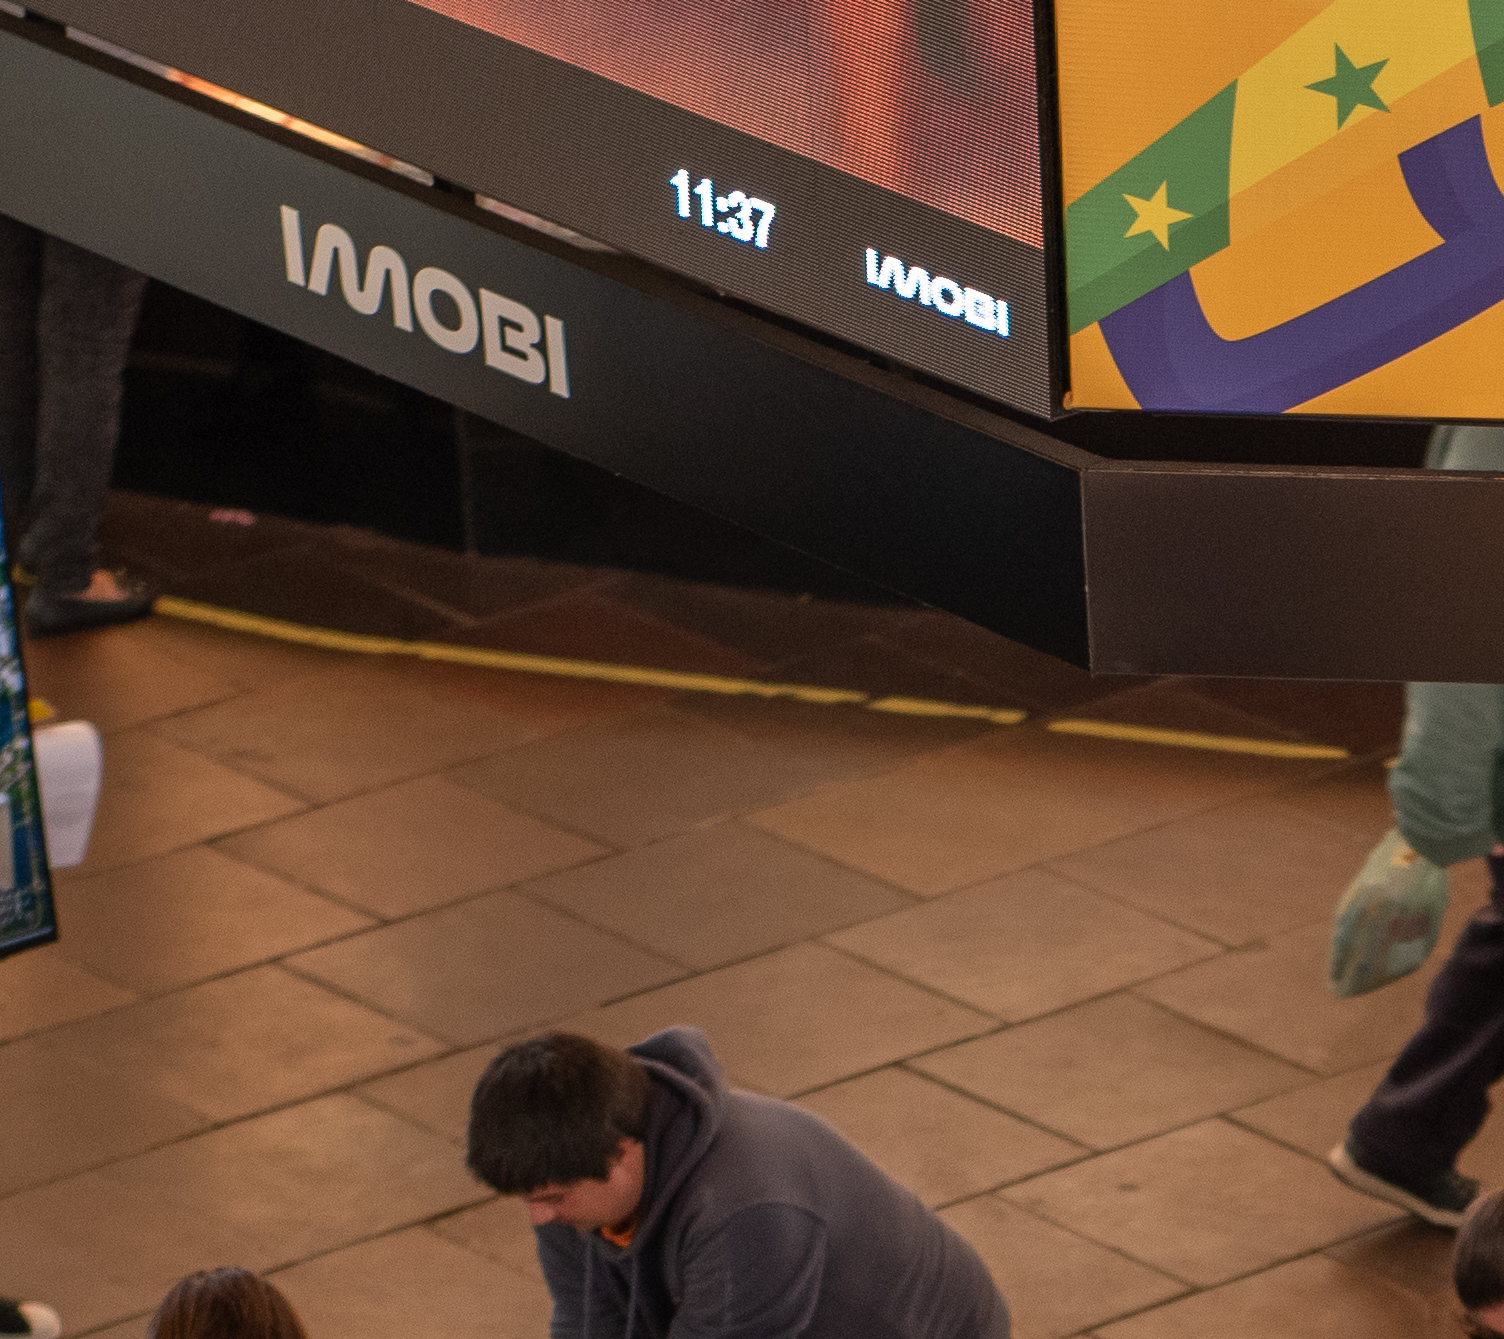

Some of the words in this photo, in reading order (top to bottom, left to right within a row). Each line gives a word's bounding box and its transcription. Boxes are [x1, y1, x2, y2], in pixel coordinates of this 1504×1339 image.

[669, 168, 777, 249] 11:37
[280, 204, 572, 398] IMOBI
[864, 247, 1011, 338] IMOBI
